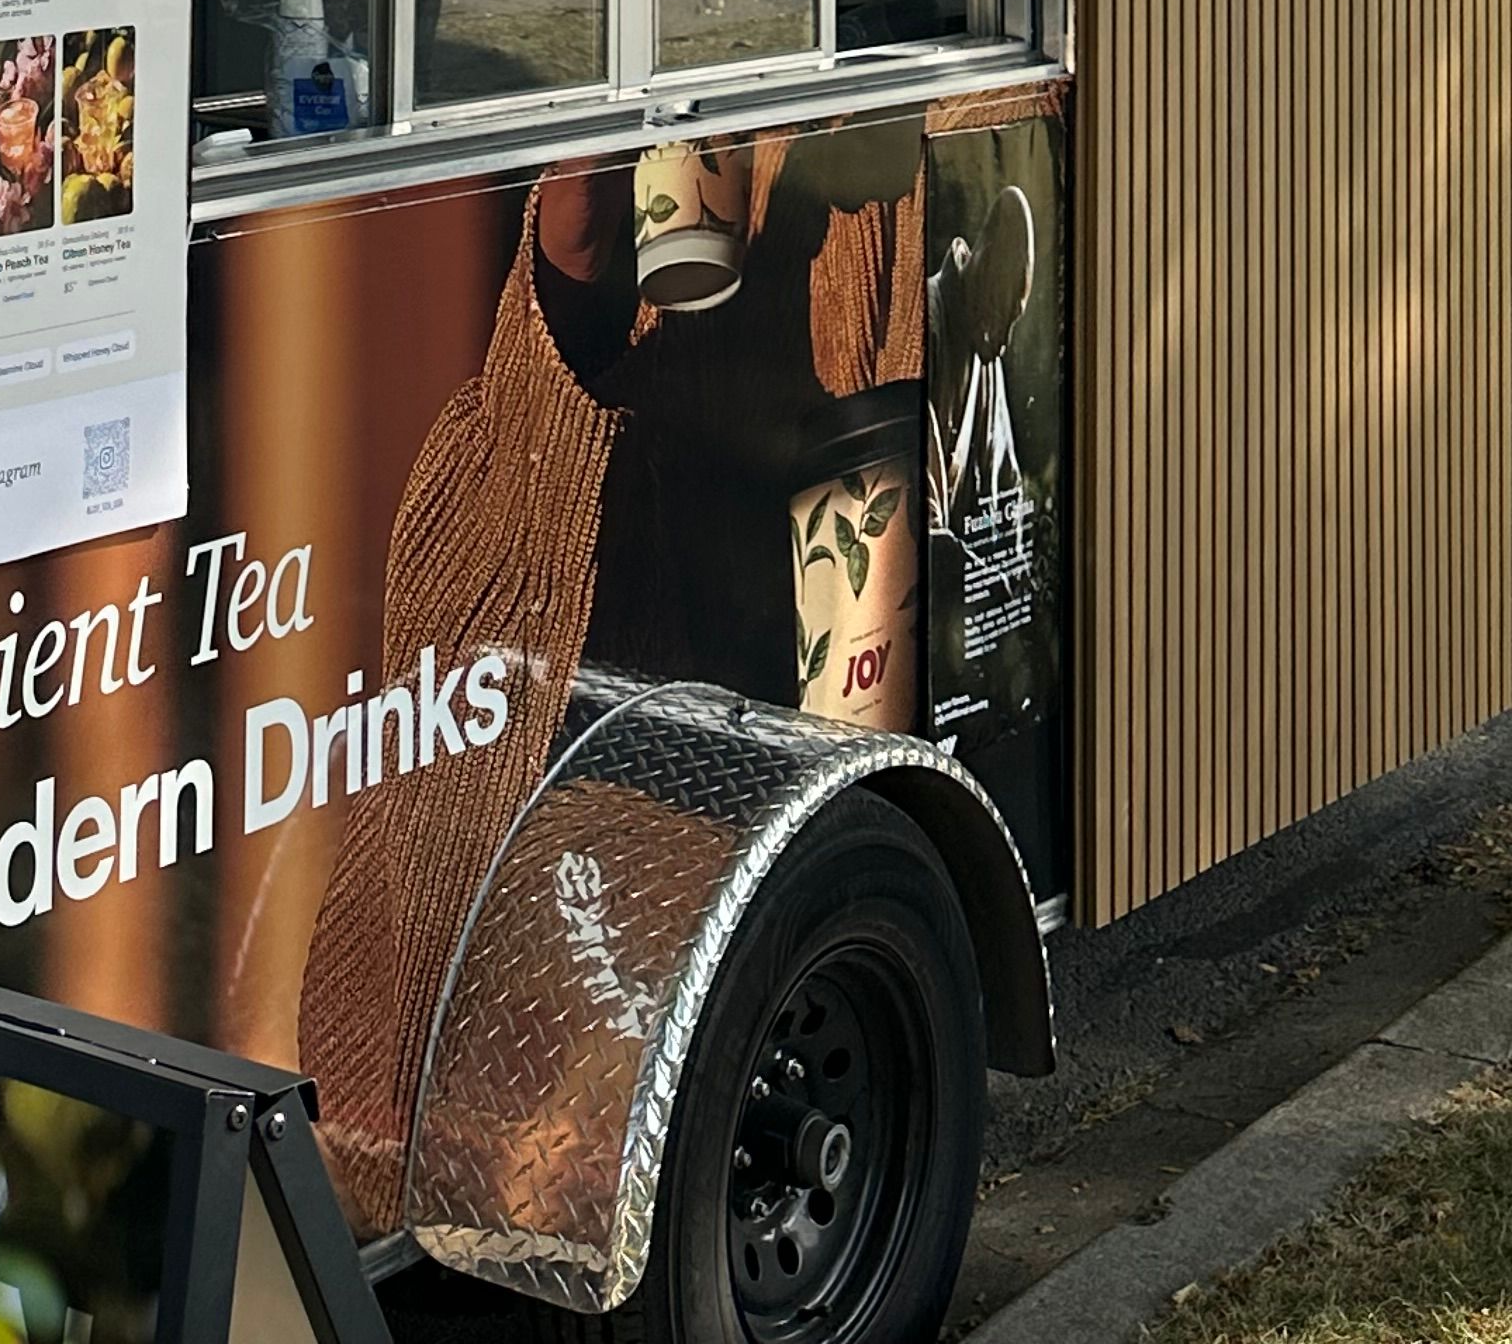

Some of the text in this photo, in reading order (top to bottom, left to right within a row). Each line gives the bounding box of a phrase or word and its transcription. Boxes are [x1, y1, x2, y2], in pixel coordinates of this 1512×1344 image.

[88, 244, 115, 255] Honey
[115, 239, 132, 250] Tea
[4, 257, 31, 271] Peach
[33, 254, 49, 265] Tea
[111, 340, 131, 353] Cloud
[24, 359, 45, 371] Cloud
[187, 531, 316, 668] Tea
[841, 639, 892, 699] JOY
[244, 643, 510, 836] Drinks
